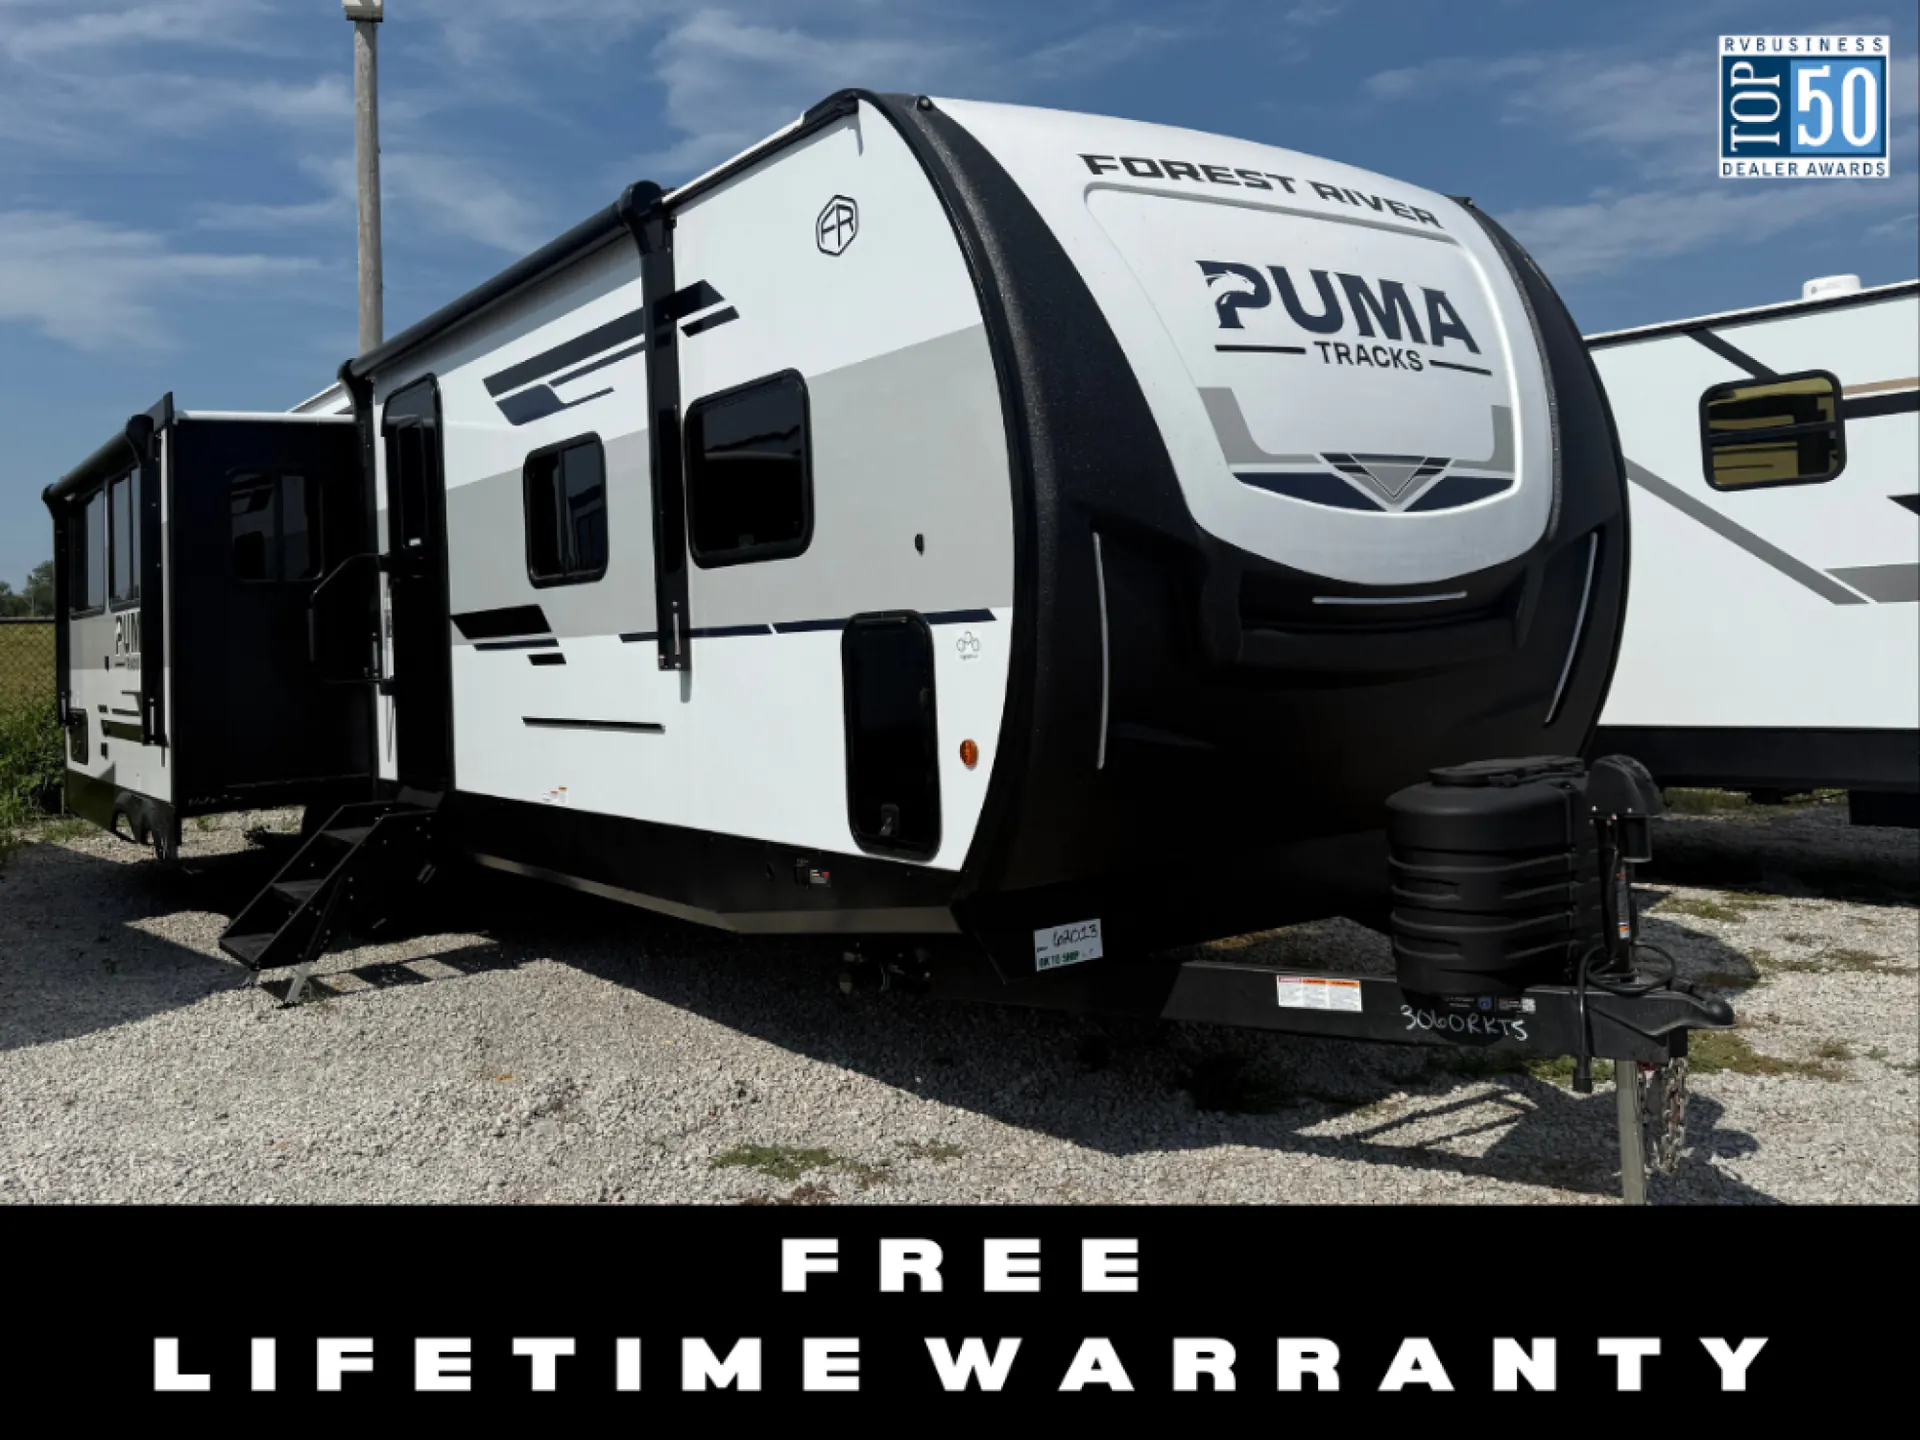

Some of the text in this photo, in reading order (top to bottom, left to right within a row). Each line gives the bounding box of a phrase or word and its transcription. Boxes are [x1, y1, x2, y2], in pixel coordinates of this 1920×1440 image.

[1078, 153, 1444, 229] FOREST RIVER
[1195, 259, 1483, 355] PUMA
[1313, 340, 1424, 372] TRACKS
[115, 612, 141, 656] PUM
